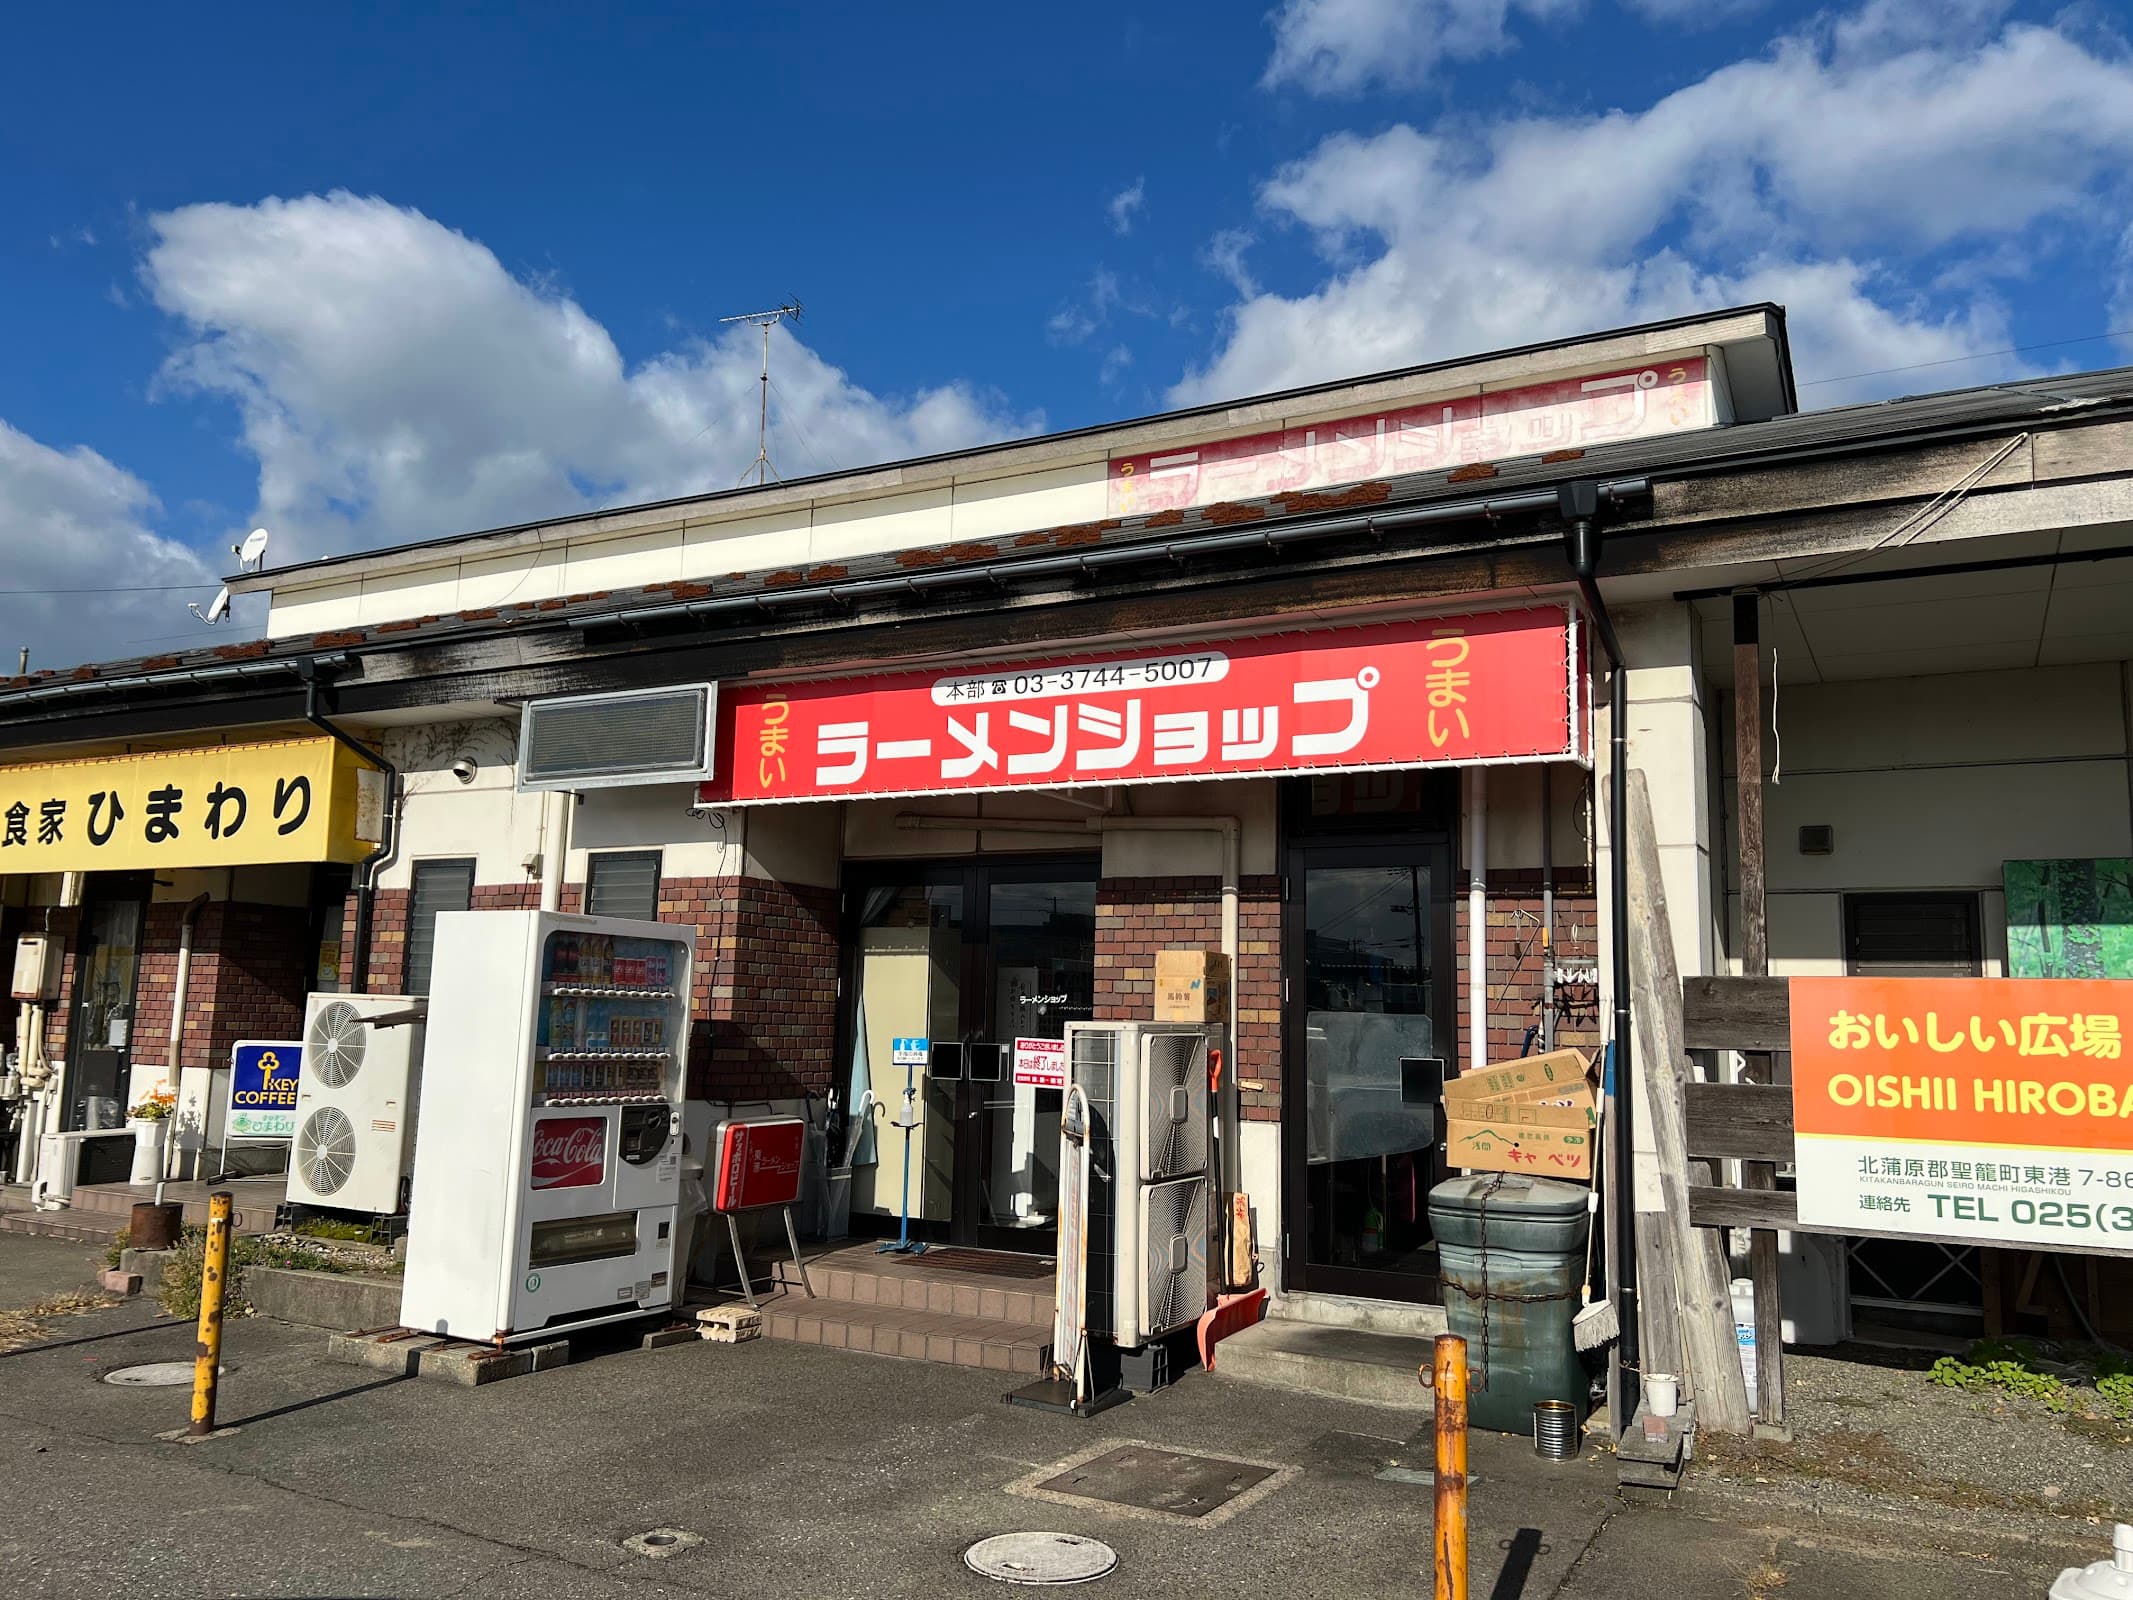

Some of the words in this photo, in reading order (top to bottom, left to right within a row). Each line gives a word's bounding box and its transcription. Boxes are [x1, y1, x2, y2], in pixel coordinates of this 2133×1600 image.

[945, 680, 985, 701] 本部
[1013, 657, 1213, 694] 03-3744-5007
[1425, 628, 1471, 748] うまい
[759, 693, 790, 789] うまい
[815, 665, 1381, 787] ラーメンショップ
[1, 797, 67, 848] 食家
[86, 775, 311, 847] ひまわり
[1828, 1010, 2123, 1060] おいしい広場
[234, 1091, 297, 1105] COFFEE
[269, 1078, 298, 1091] KEY
[1828, 1073, 1958, 1112] OISHII
[1507, 1149, 1581, 1167] キャベツ
[1859, 1176, 1944, 1189] KITAKANBARAGUN
[1946, 1181, 1975, 1191] SEIRO
[1977, 1183, 2009, 1193] MACHI
[2011, 1186, 2072, 1197] HIGASHIKOU
[1859, 1194, 1911, 1213] 連絡先
[1927, 1193, 2000, 1223] TEL
